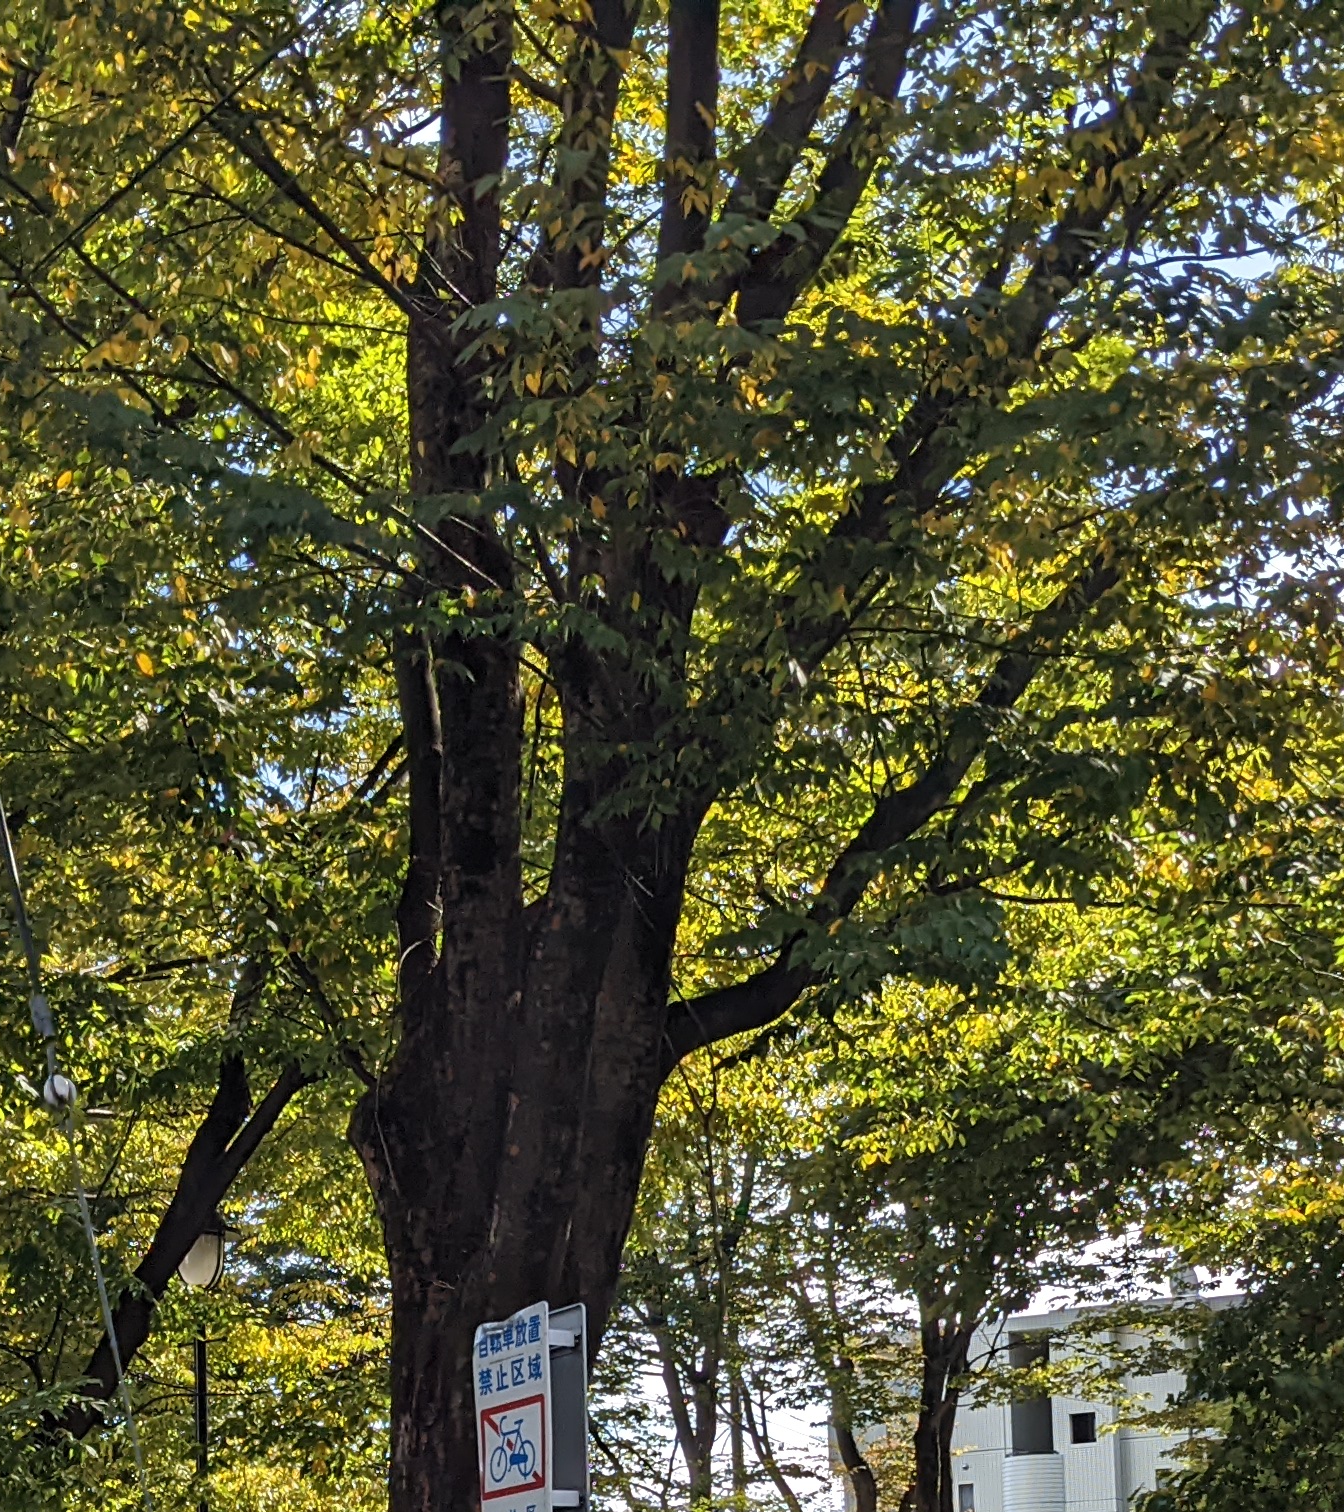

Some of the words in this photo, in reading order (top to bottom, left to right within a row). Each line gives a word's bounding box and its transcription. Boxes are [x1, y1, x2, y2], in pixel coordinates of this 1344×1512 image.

[478, 1315, 541, 1358] 自転車放置
[478, 1353, 543, 1396] 禁止区域
